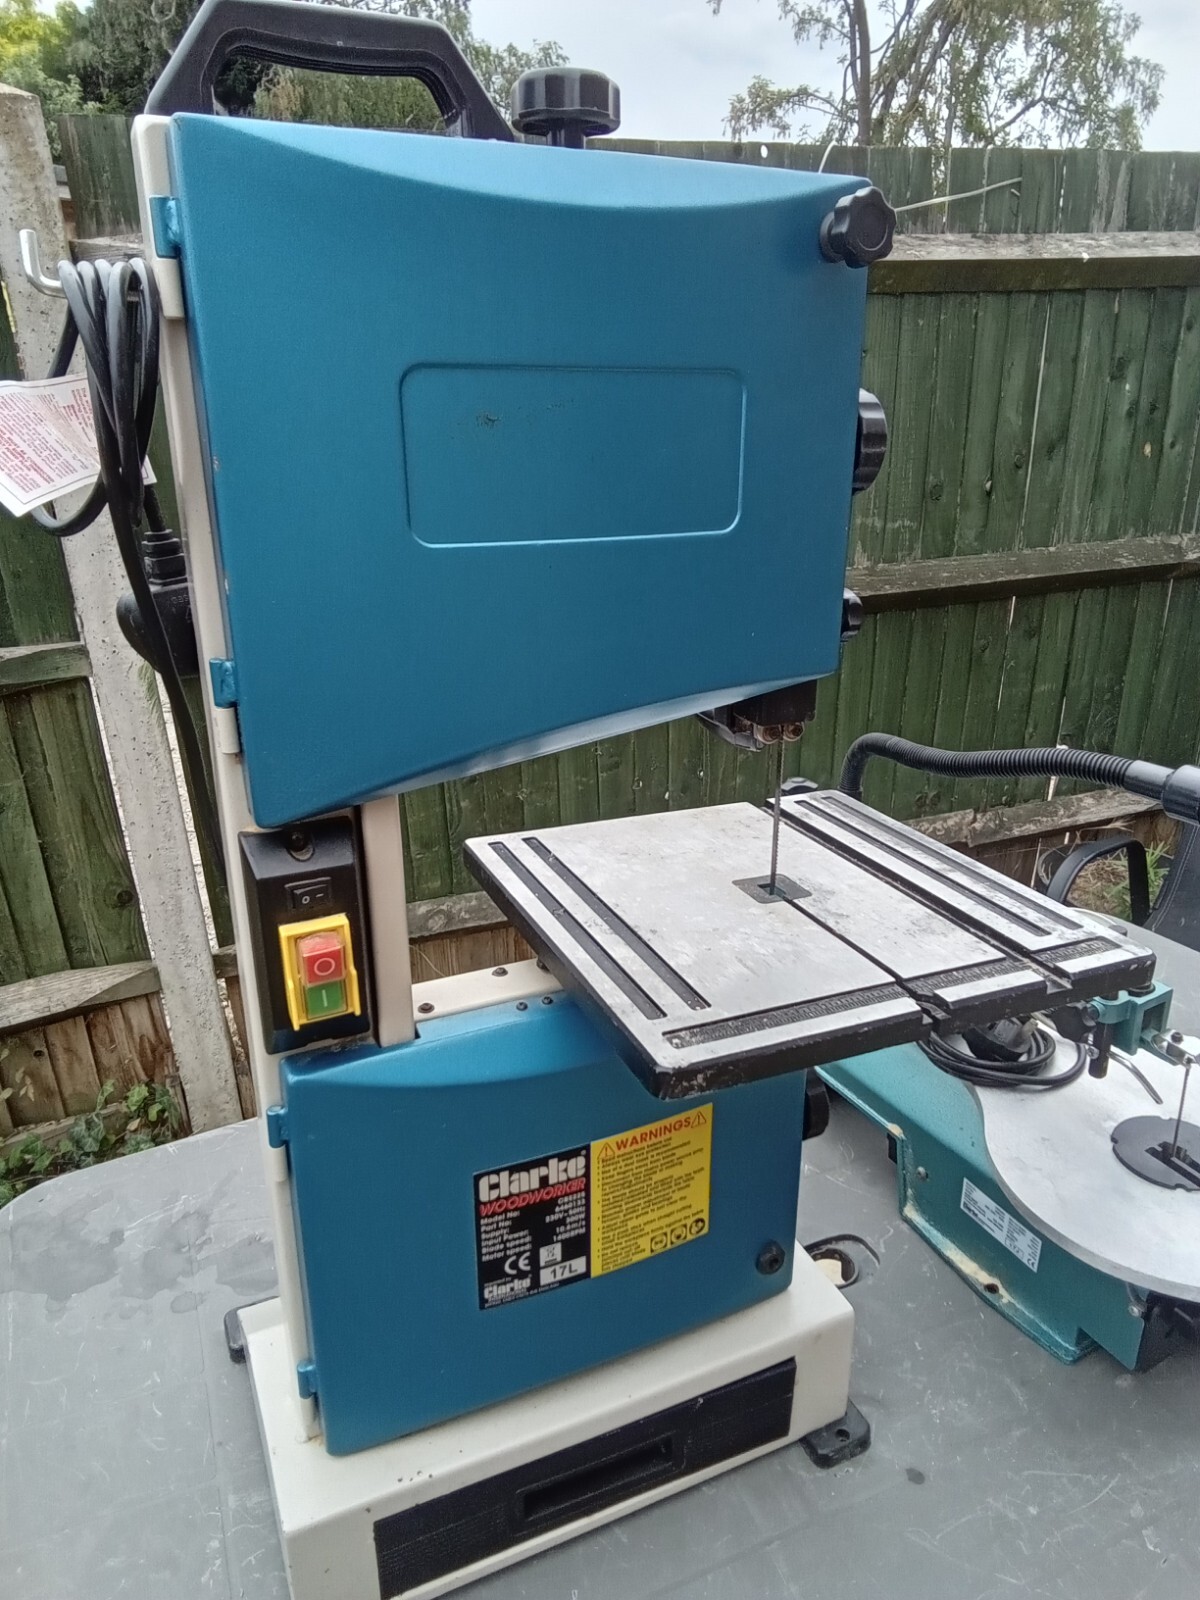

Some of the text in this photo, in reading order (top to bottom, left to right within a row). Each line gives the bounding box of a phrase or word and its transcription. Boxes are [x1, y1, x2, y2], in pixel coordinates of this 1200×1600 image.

[615, 1116, 691, 1150] WARNINGS
[479, 1155, 586, 1202] Clarke
[480, 1177, 586, 1217] WOODWORKER
[480, 1212, 505, 1225] Model
[507, 1210, 520, 1219] No:
[481, 1222, 497, 1232] Part
[498, 1219, 512, 1228] No:
[481, 1228, 510, 1240] Supply:
[481, 1235, 502, 1247] Input
[503, 1229, 529, 1242] Power:
[481, 1242, 504, 1255] Blade
[506, 1235, 532, 1248] speed:
[482, 1250, 505, 1262] Motor
[506, 1243, 532, 1256] speed:
[550, 1263, 578, 1279] 17L
